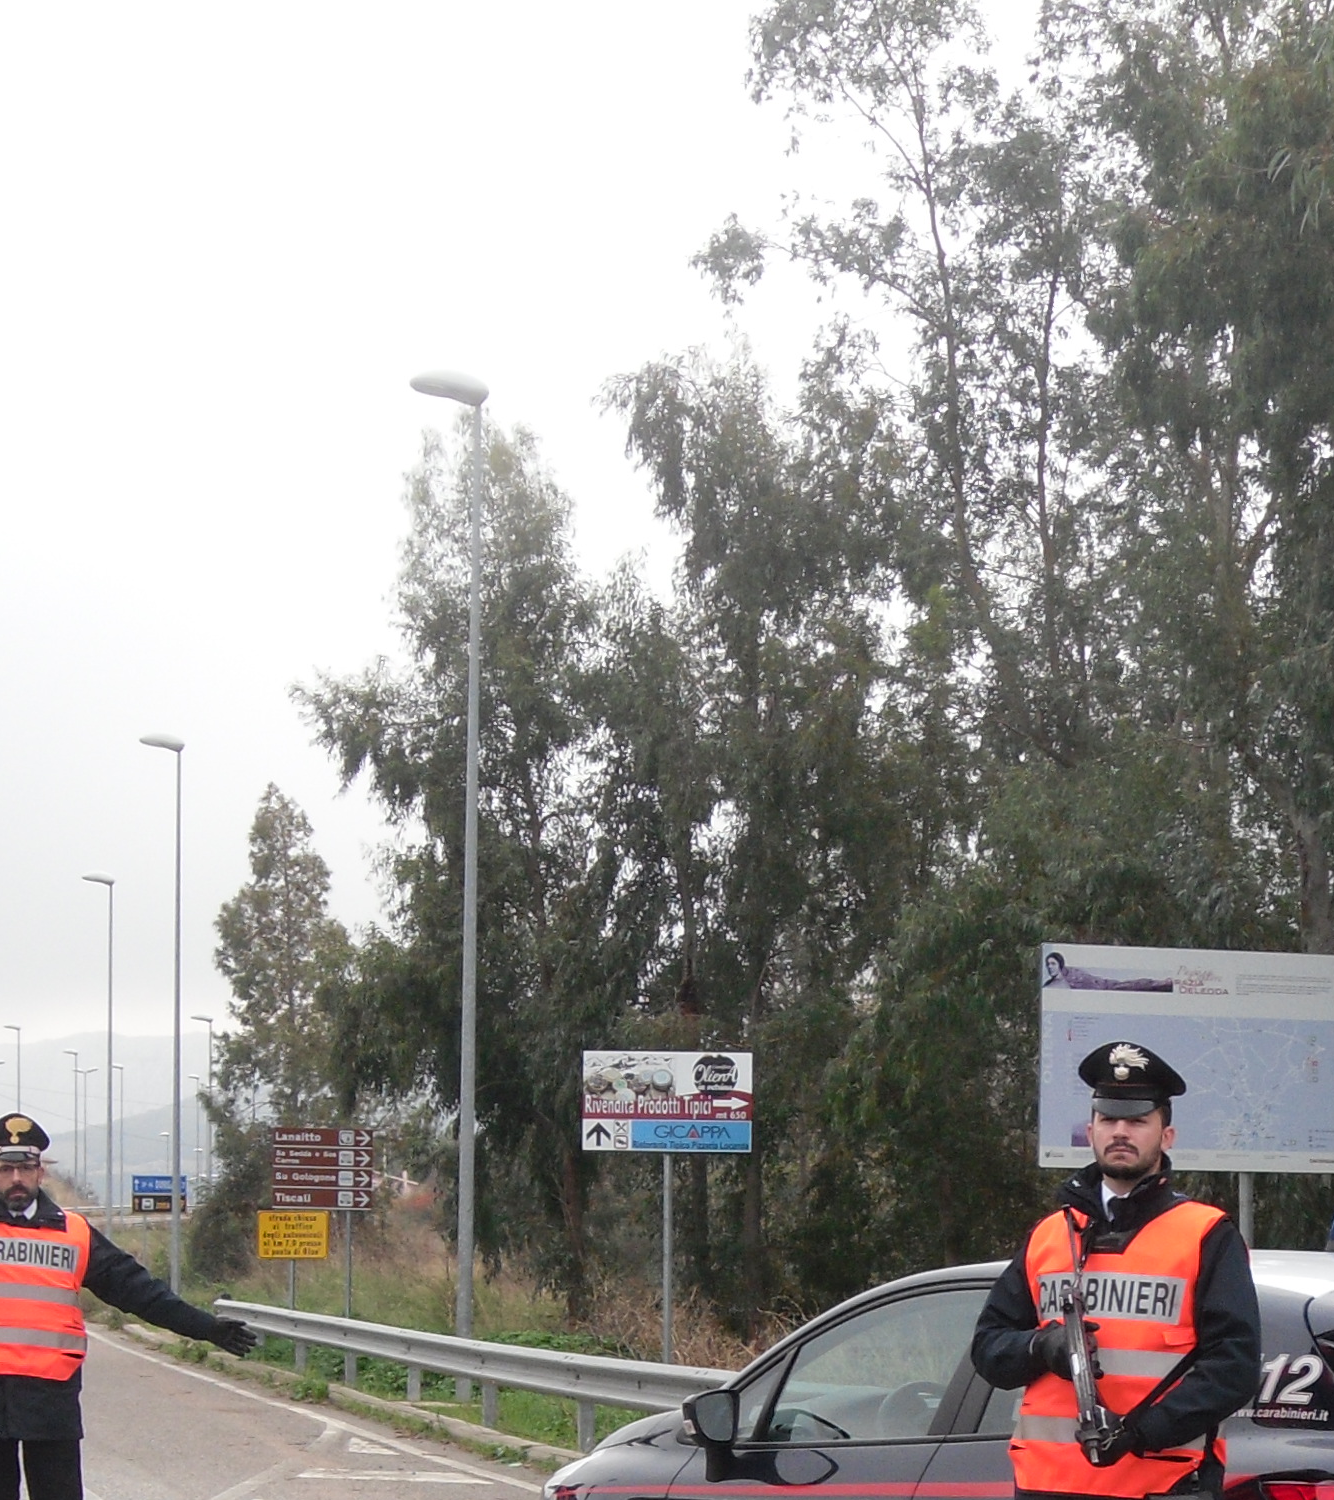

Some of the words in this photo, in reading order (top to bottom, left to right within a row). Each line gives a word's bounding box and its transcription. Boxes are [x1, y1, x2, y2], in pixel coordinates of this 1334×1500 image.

[585, 1095, 634, 1114] Rivendita
[638, 1095, 680, 1115] Prodotti
[683, 1095, 712, 1119] Tipici
[730, 1111, 747, 1119] 650
[275, 1131, 322, 1142] Lanaitto
[654, 1124, 731, 1139] GICAPPA
[275, 1192, 311, 1203] Tiscali
[1040, 1277, 1177, 1317] CARBINIERI
[1258, 1353, 1324, 1405] 12
